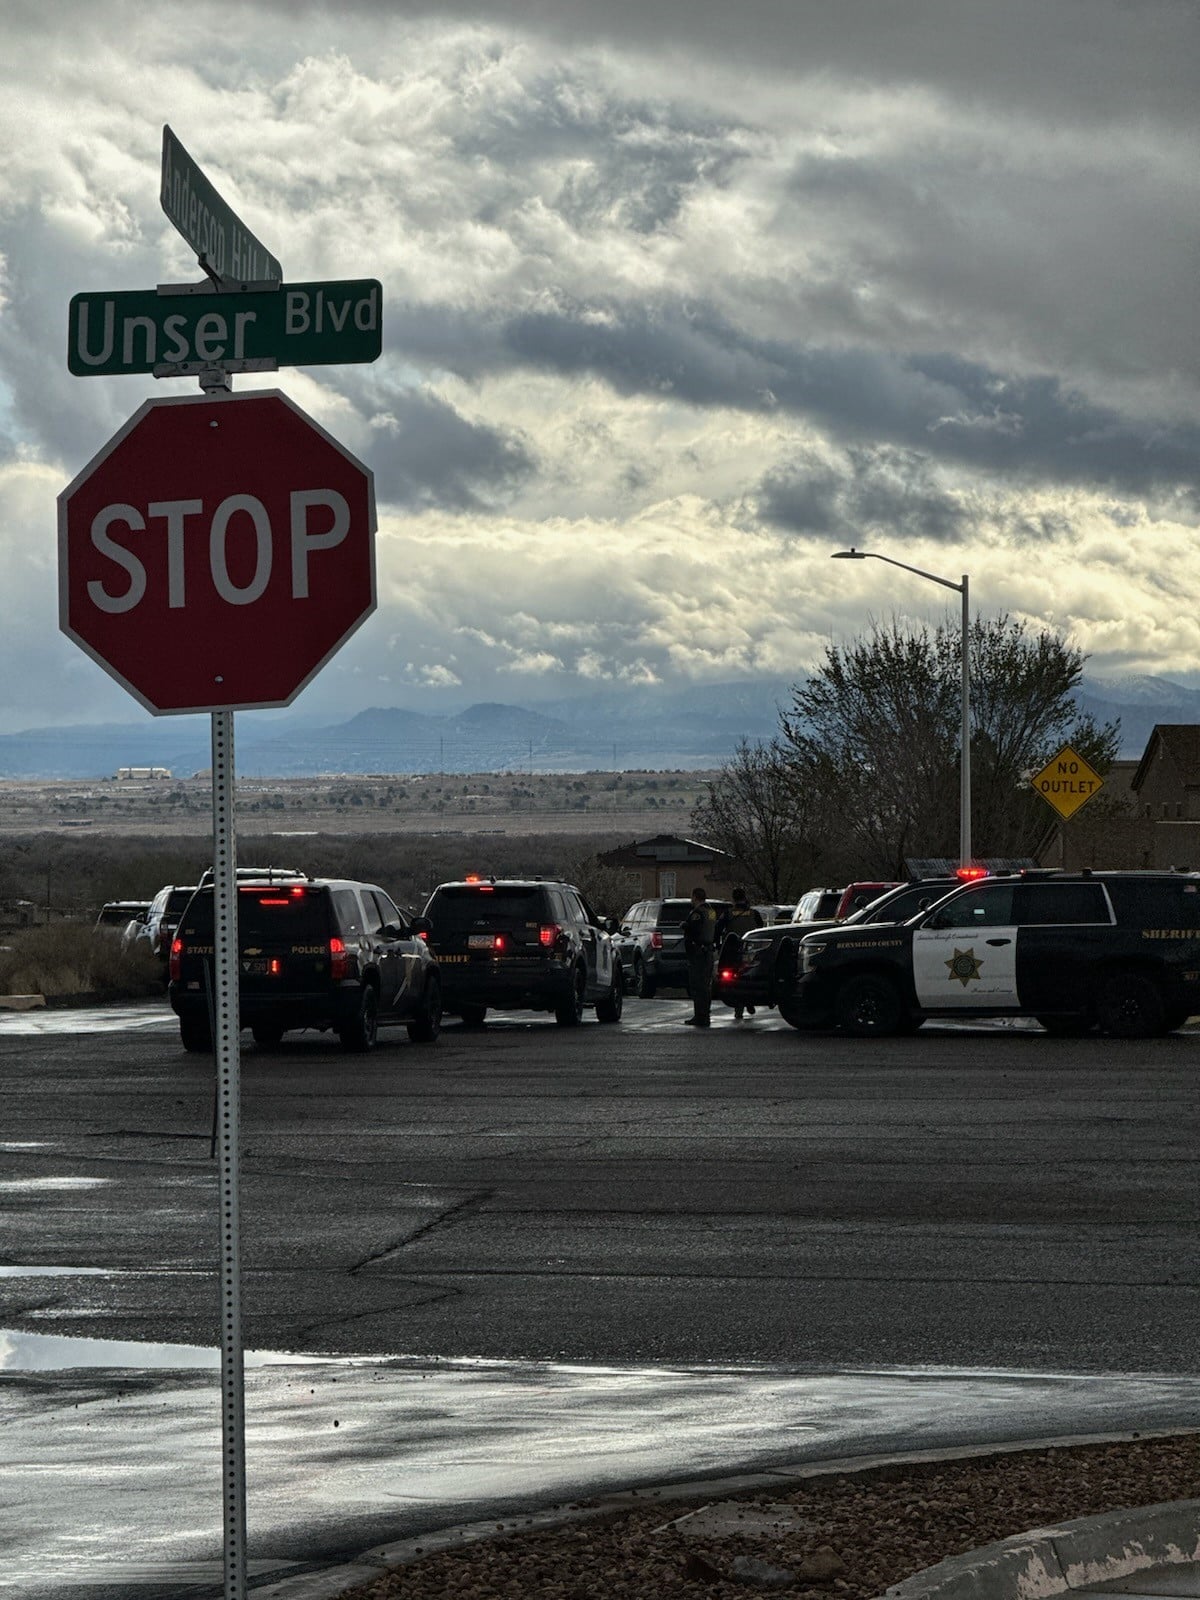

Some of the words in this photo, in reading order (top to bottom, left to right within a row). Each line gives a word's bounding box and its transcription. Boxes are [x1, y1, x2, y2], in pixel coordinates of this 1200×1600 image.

[163, 138, 225, 278] Anderson
[232, 224, 257, 281] Hill
[78, 301, 257, 366] Unser
[285, 289, 378, 336] Blvd
[86, 488, 352, 614] STOP
[1041, 780, 1095, 793] OUTLET
[1058, 762, 1079, 774] NO
[187, 946, 215, 955] STATE
[291, 945, 326, 955] POLICE
